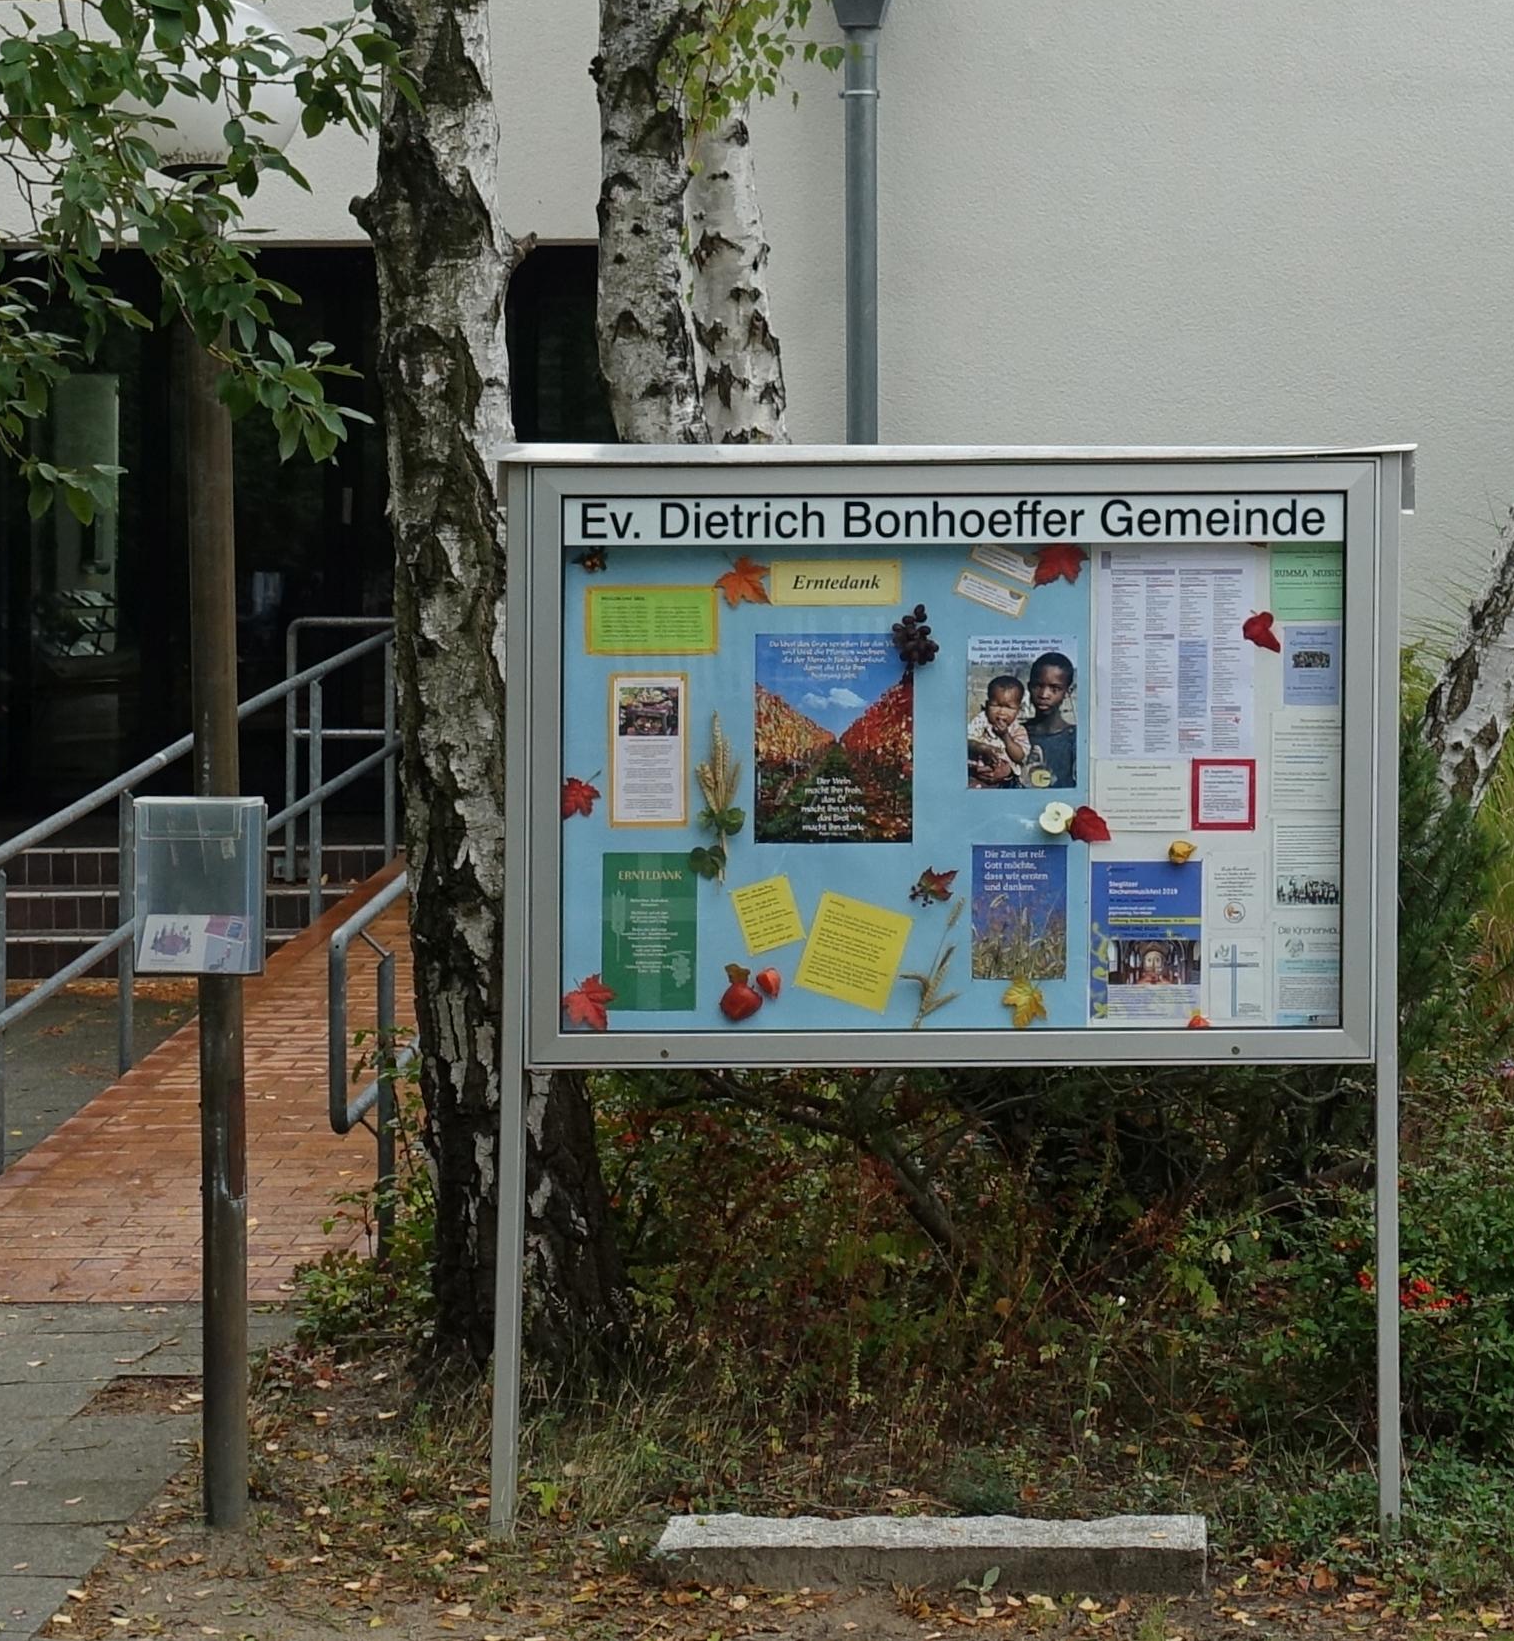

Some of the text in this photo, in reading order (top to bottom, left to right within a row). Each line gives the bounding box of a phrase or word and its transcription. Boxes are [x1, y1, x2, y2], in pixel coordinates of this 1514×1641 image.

[581, 501, 1326, 539] Ev. Dietrich Bonhoeffer Gemeinde
[792, 573, 881, 591] Erntedank
[984, 849, 999, 858] Die
[1000, 849, 1017, 858] Zeit
[1018, 849, 1029, 858] ist
[984, 861, 1002, 870] Gott
[618, 870, 683, 880] ERNTEDANK
[1004, 871, 1020, 880] wir
[984, 882, 1001, 891] und
